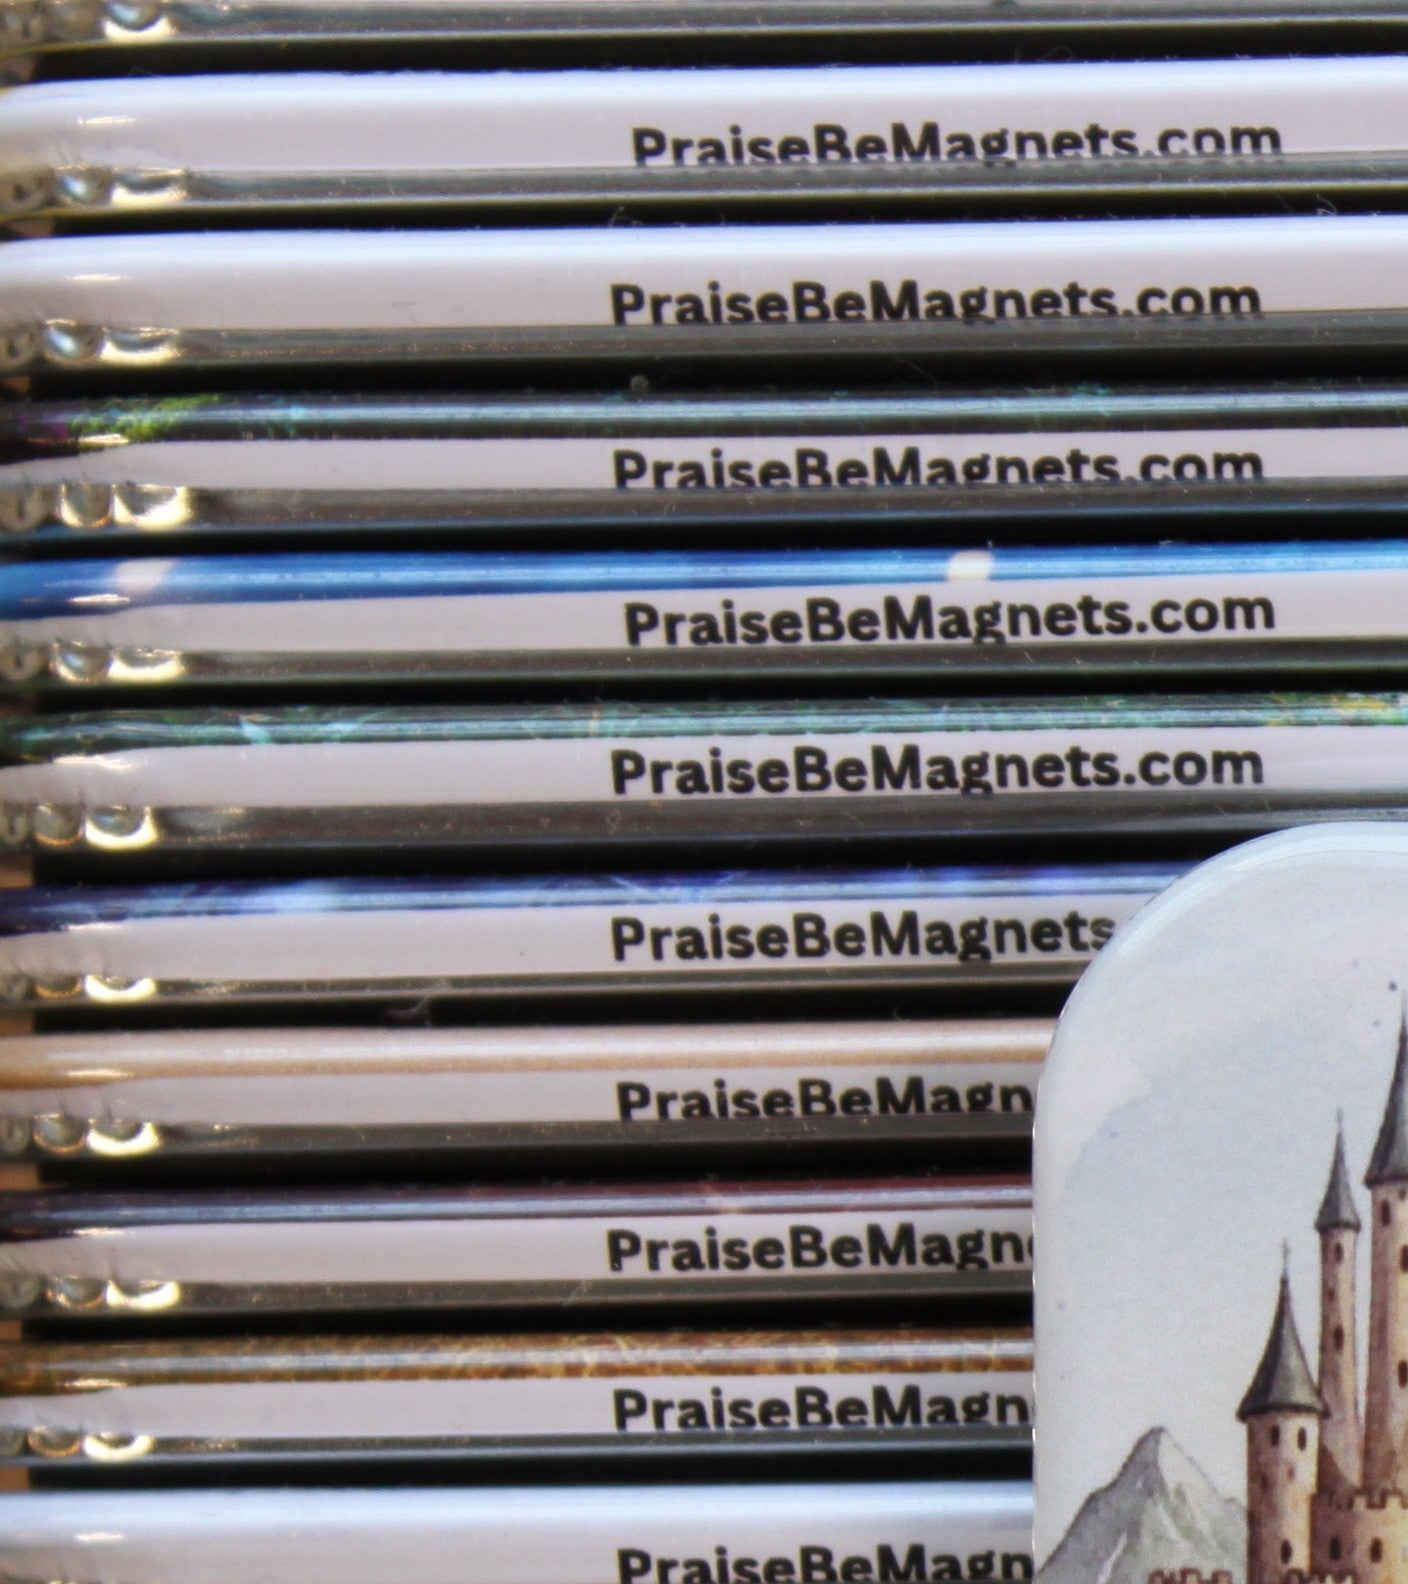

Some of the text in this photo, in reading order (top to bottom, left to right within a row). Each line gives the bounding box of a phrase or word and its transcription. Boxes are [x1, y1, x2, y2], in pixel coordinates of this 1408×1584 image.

[611, 280, 1262, 325] PraiseBeMagnets.com
[613, 446, 1263, 492] PraiseBeMagnets.com
[623, 594, 1275, 646] PraiseBeMagnets.com
[611, 745, 1263, 796] PraiseBeMagnets.com
[611, 910, 1116, 963] PraiseBeMagnets
[616, 1075, 1033, 1121] PraiseBeMagn
[606, 1223, 1034, 1272] PraiseBeMagn
[612, 1384, 1034, 1431] PraiseBeMagn
